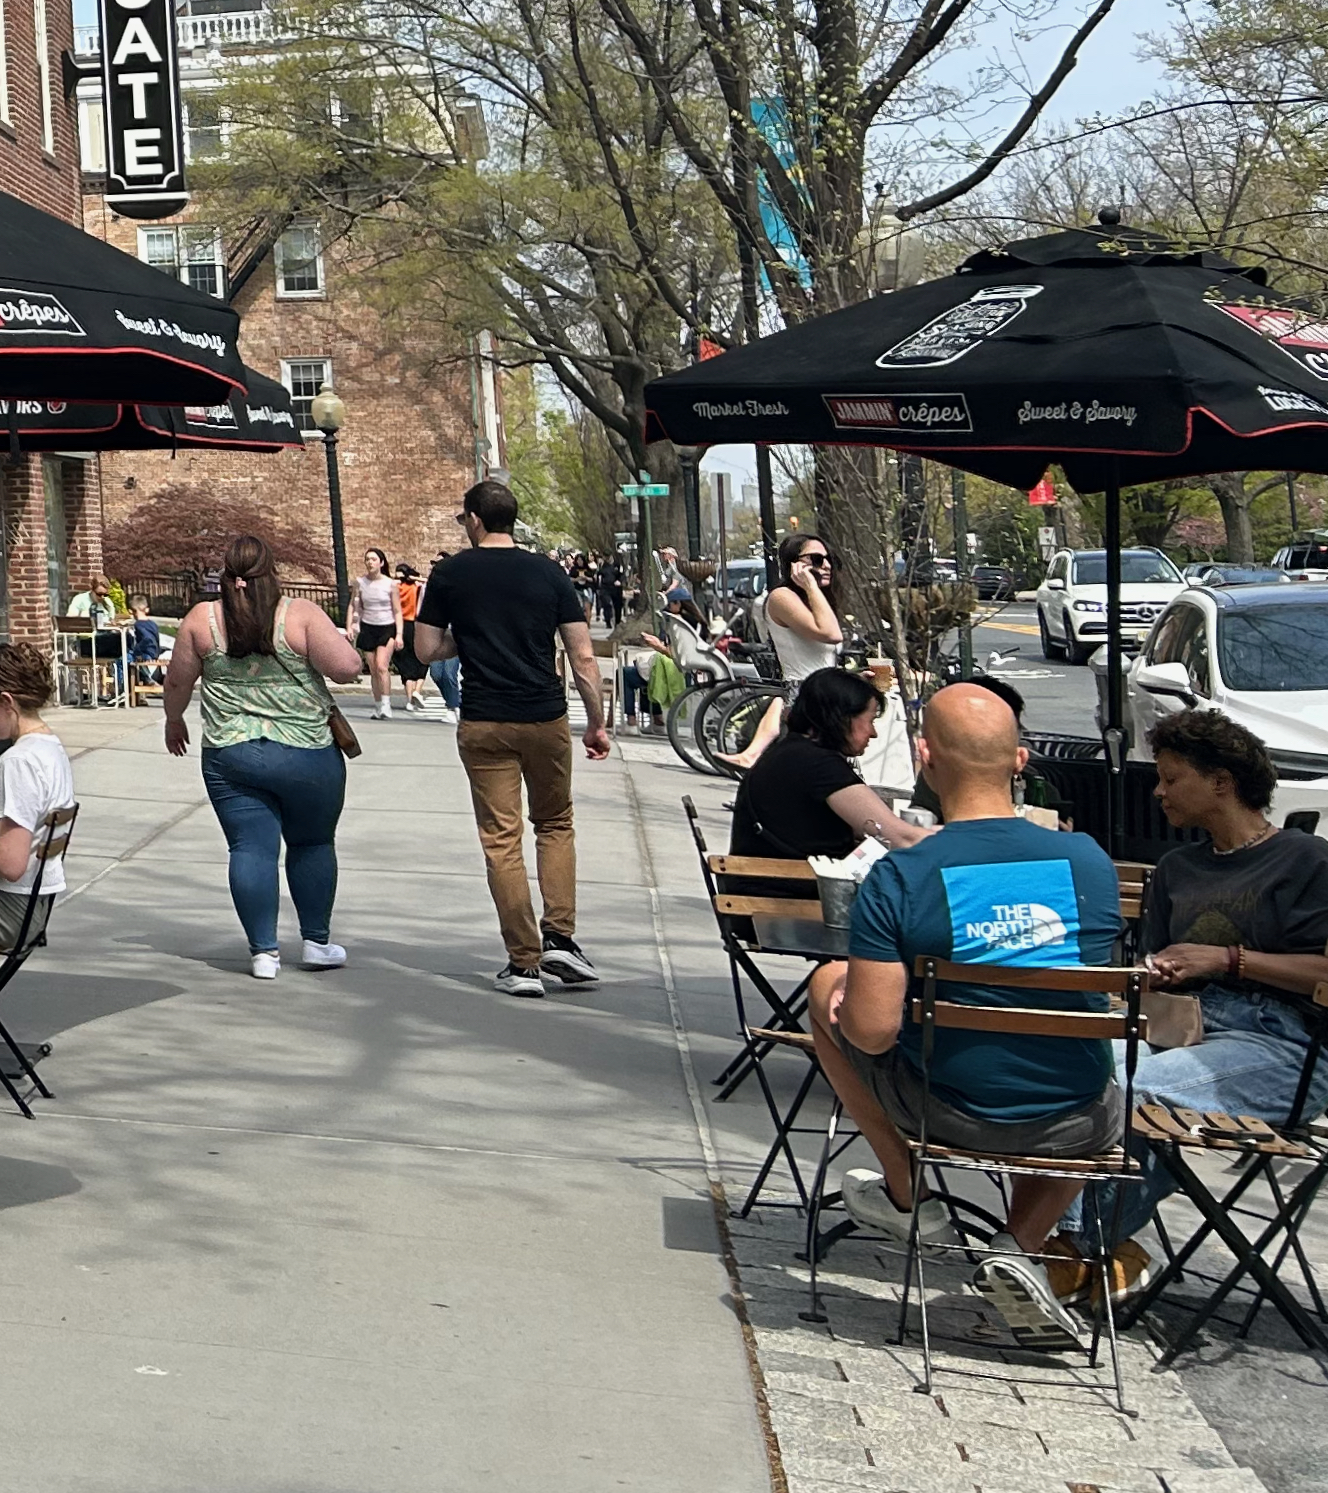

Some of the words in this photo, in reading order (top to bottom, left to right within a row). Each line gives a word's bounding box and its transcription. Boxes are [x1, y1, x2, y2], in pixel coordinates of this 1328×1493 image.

[692, 401, 747, 420] Market
[746, 400, 789, 417] Fresh
[835, 402, 894, 422] JAMMIN'
[899, 403, 966, 426] crêpes
[1017, 400, 1069, 425] Sweet
[1069, 401, 1084, 420] &
[1086, 399, 1137, 426] Savory
[991, 903, 1031, 921] THE
[966, 918, 1033, 939] NORTH
[986, 934, 1035, 950] FACE
